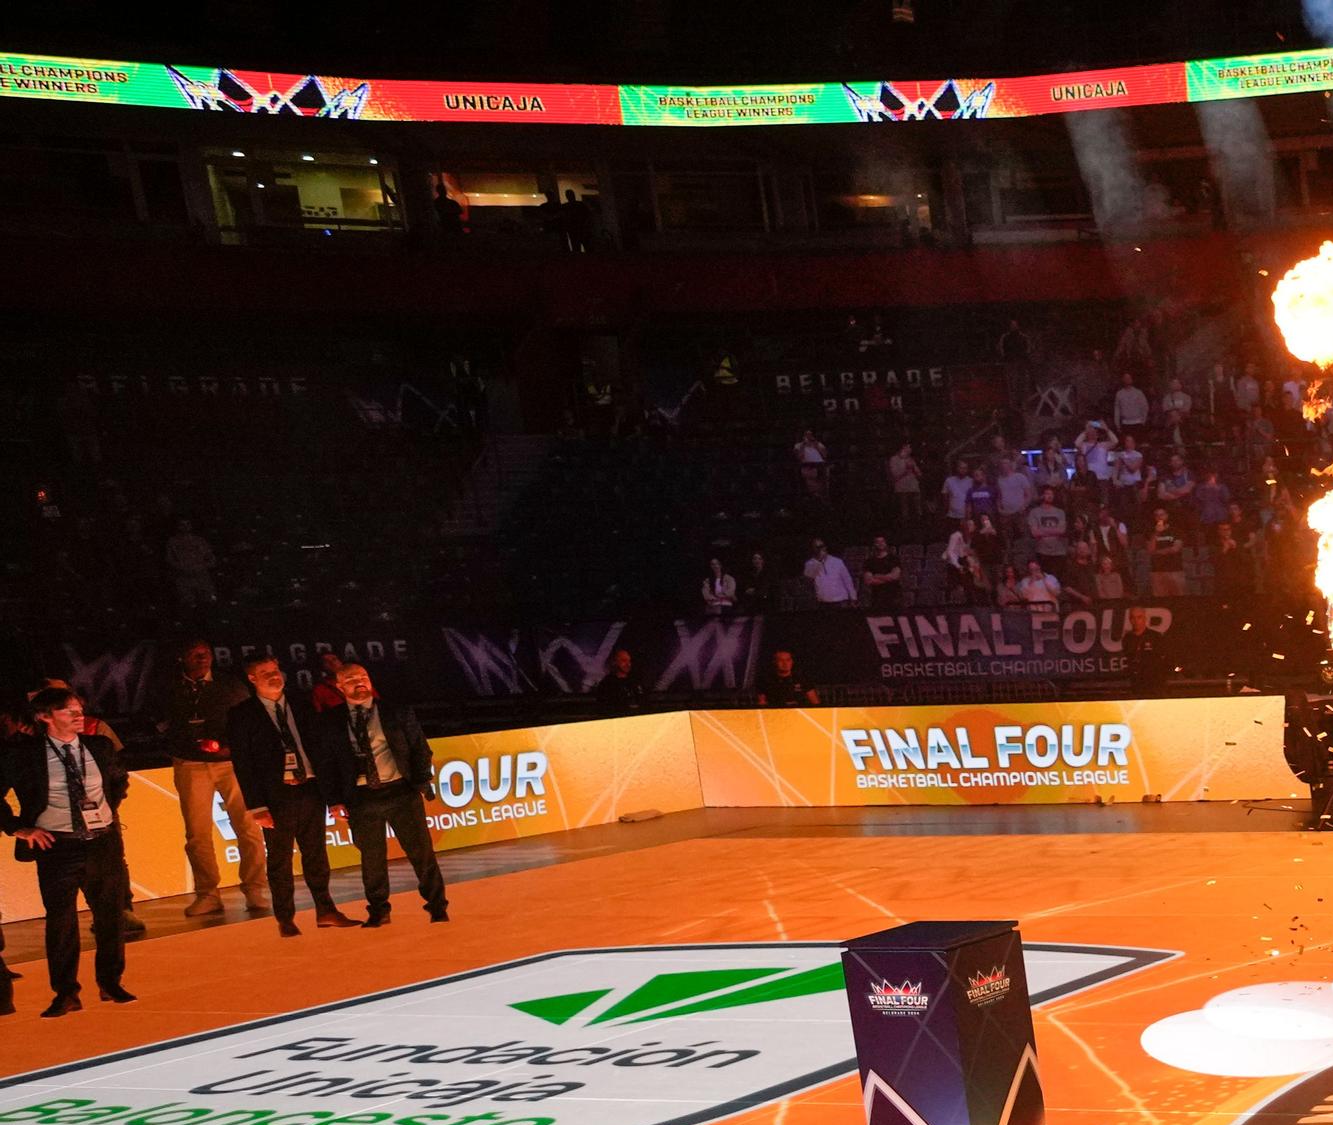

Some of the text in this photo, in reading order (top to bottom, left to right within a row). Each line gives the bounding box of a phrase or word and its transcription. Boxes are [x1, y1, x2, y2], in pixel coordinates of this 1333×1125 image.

[20, 65, 129, 83] CHAMPIONS
[14, 78, 98, 94] WINNERS
[1051, 79, 1127, 103] UNICAJA
[444, 93, 545, 112] UNICAJA
[658, 94, 815, 107] BASKETBALL CHAMPIONS
[686, 107, 793, 119] LEAGUE WINNERS
[866, 613, 1022, 659] FINAL
[990, 658, 1096, 677] CHAMPIONS
[840, 723, 1132, 771] FINAL FOUR
[431, 751, 548, 808] OUR
[856, 769, 1130, 789] BASKETBALL CHAMPIONS LEAGUE
[481, 799, 548, 824] LEAGUE
[868, 995, 929, 1006] FINAL FOUR
[233, 1036, 760, 1070] Fundación
[188, 1070, 587, 1108] Unicaja
